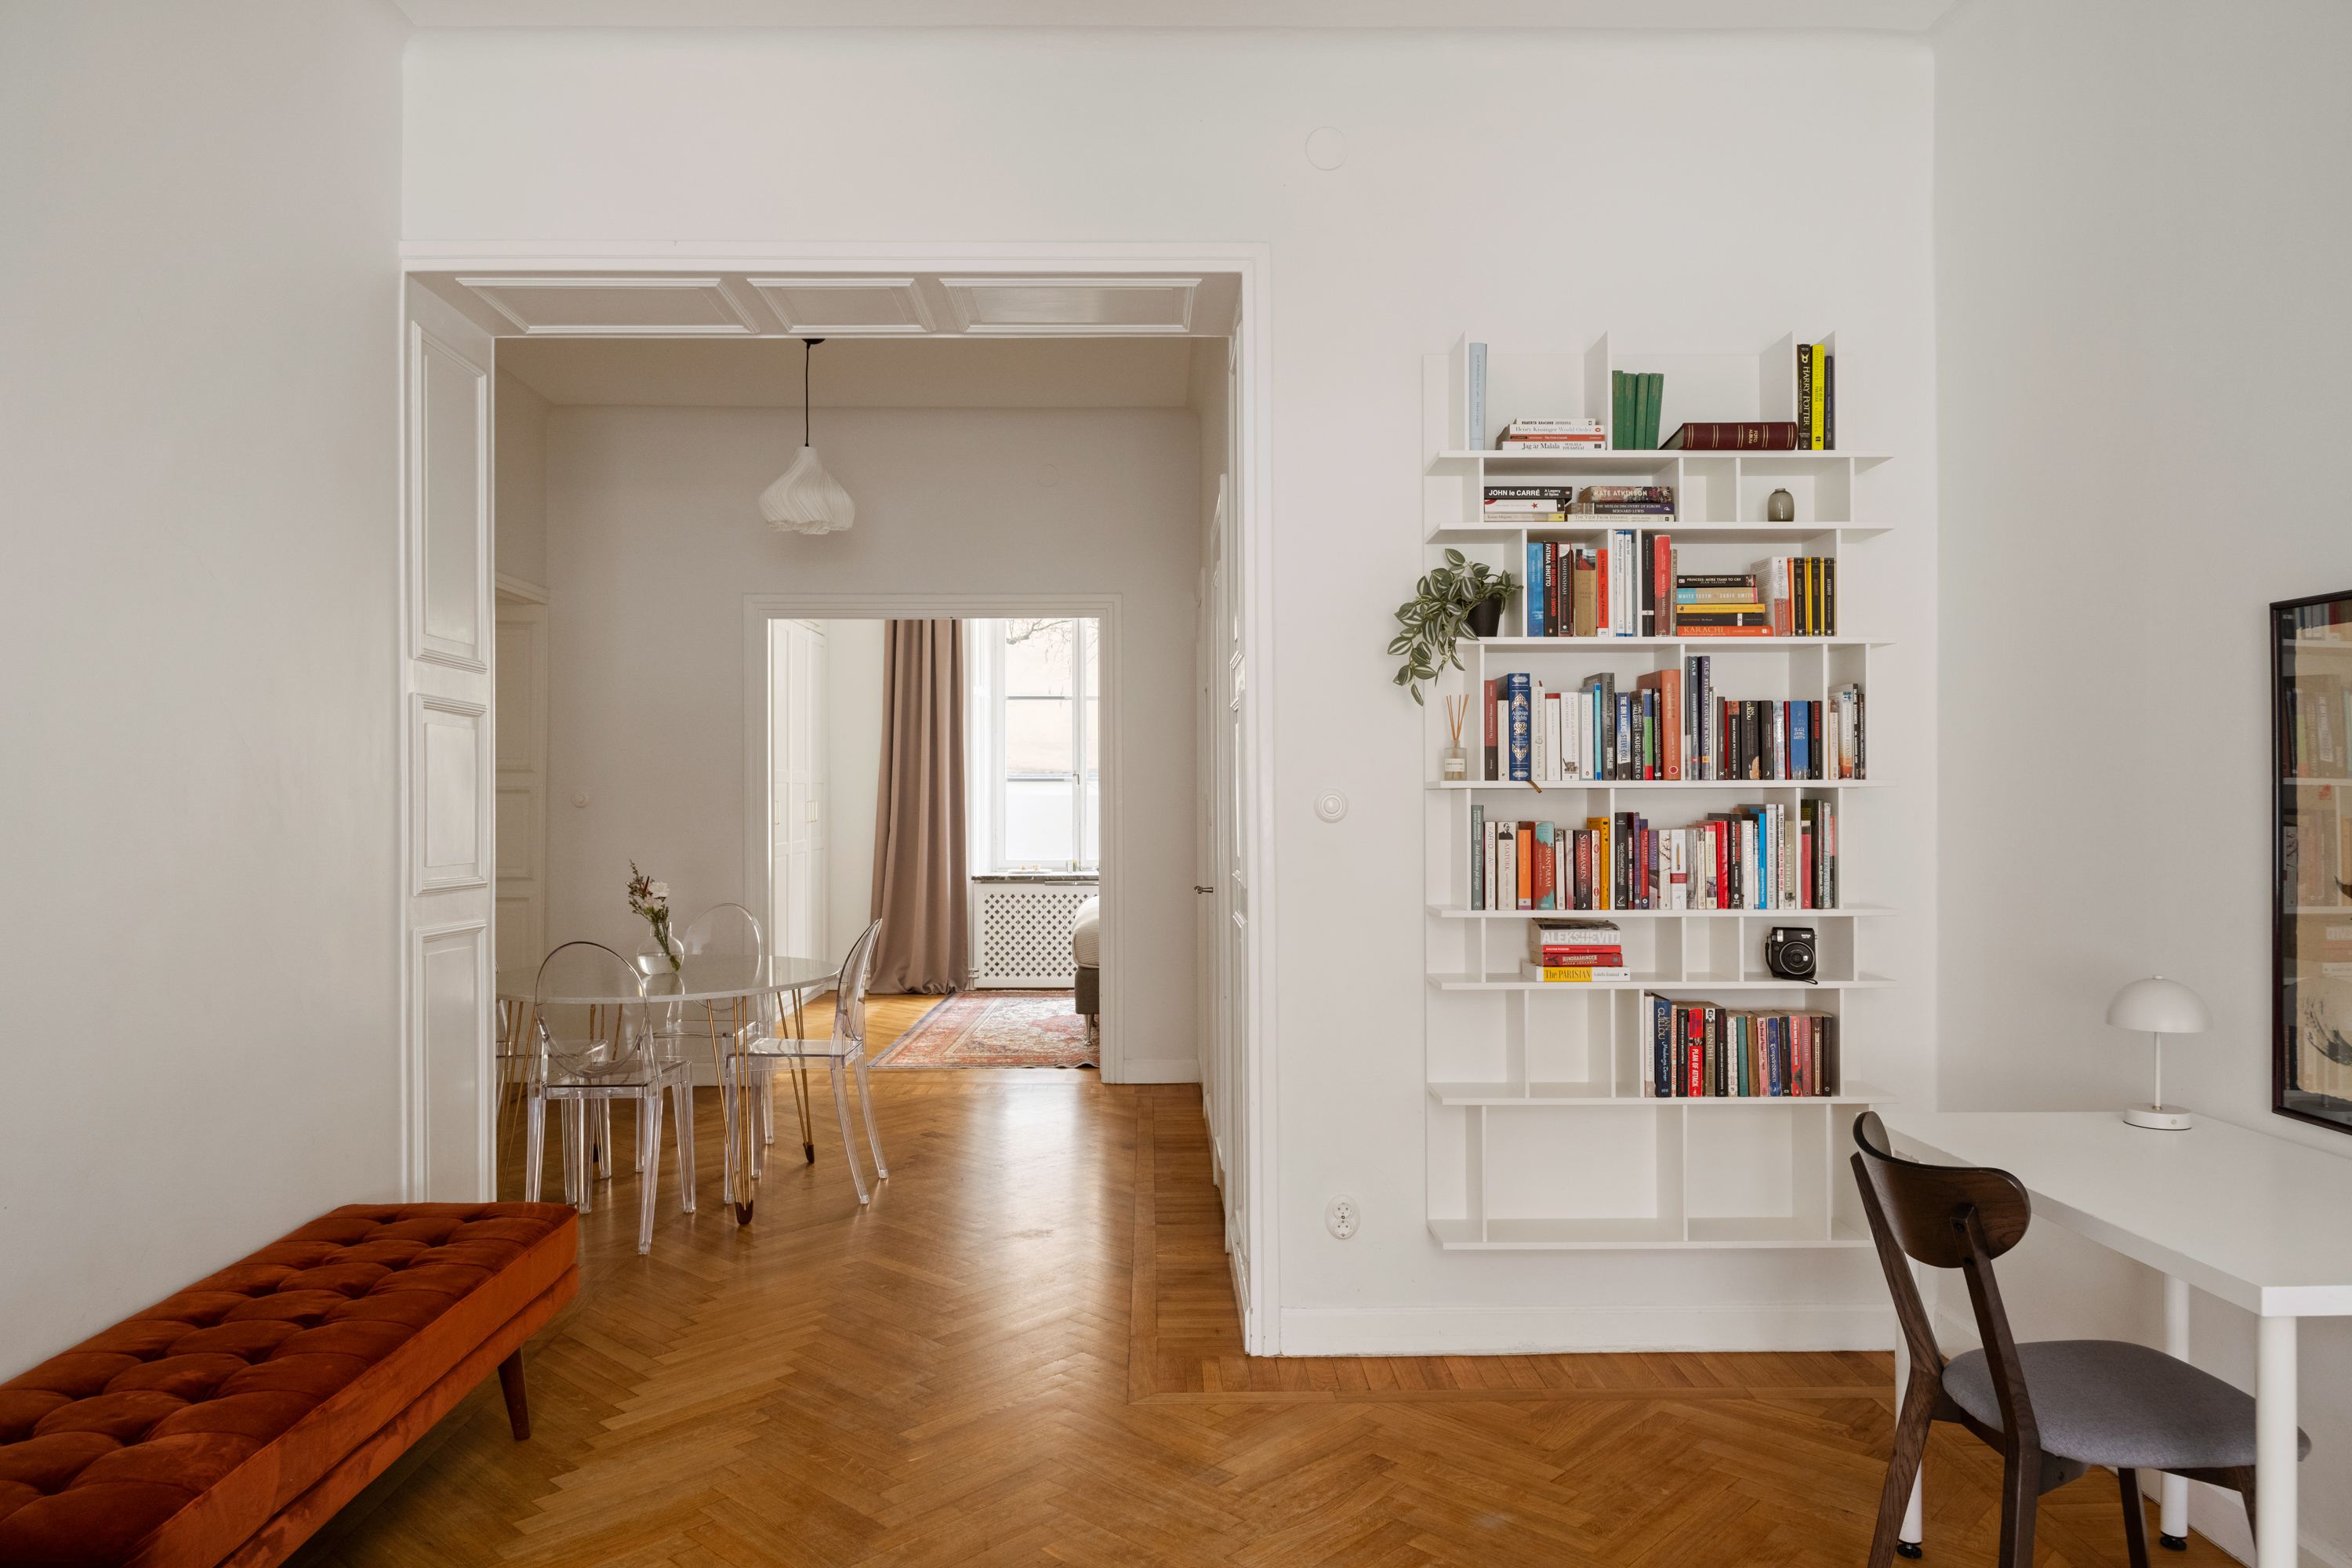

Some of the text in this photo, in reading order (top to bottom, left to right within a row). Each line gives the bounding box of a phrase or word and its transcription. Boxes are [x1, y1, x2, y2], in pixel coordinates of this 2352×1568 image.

[1579, 834, 1588, 879] SILKESMASKEN
[1544, 970, 1591, 978] The PARISIAN
